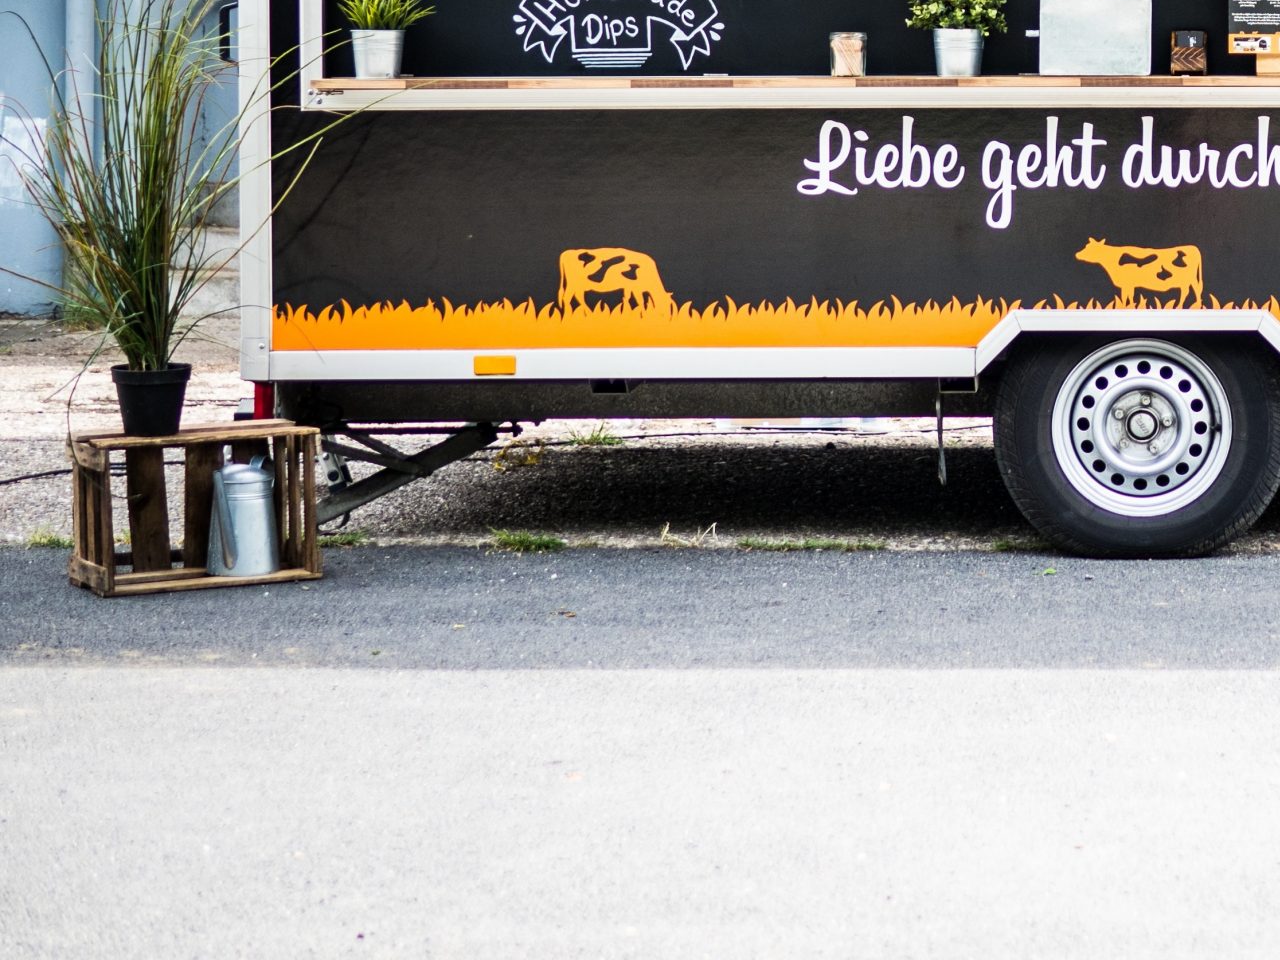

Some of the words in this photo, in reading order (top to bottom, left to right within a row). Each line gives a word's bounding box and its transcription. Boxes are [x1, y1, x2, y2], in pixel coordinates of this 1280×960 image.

[581, 13, 639, 46] Dips
[797, 115, 966, 196] Liebe
[981, 115, 1108, 229] geht
